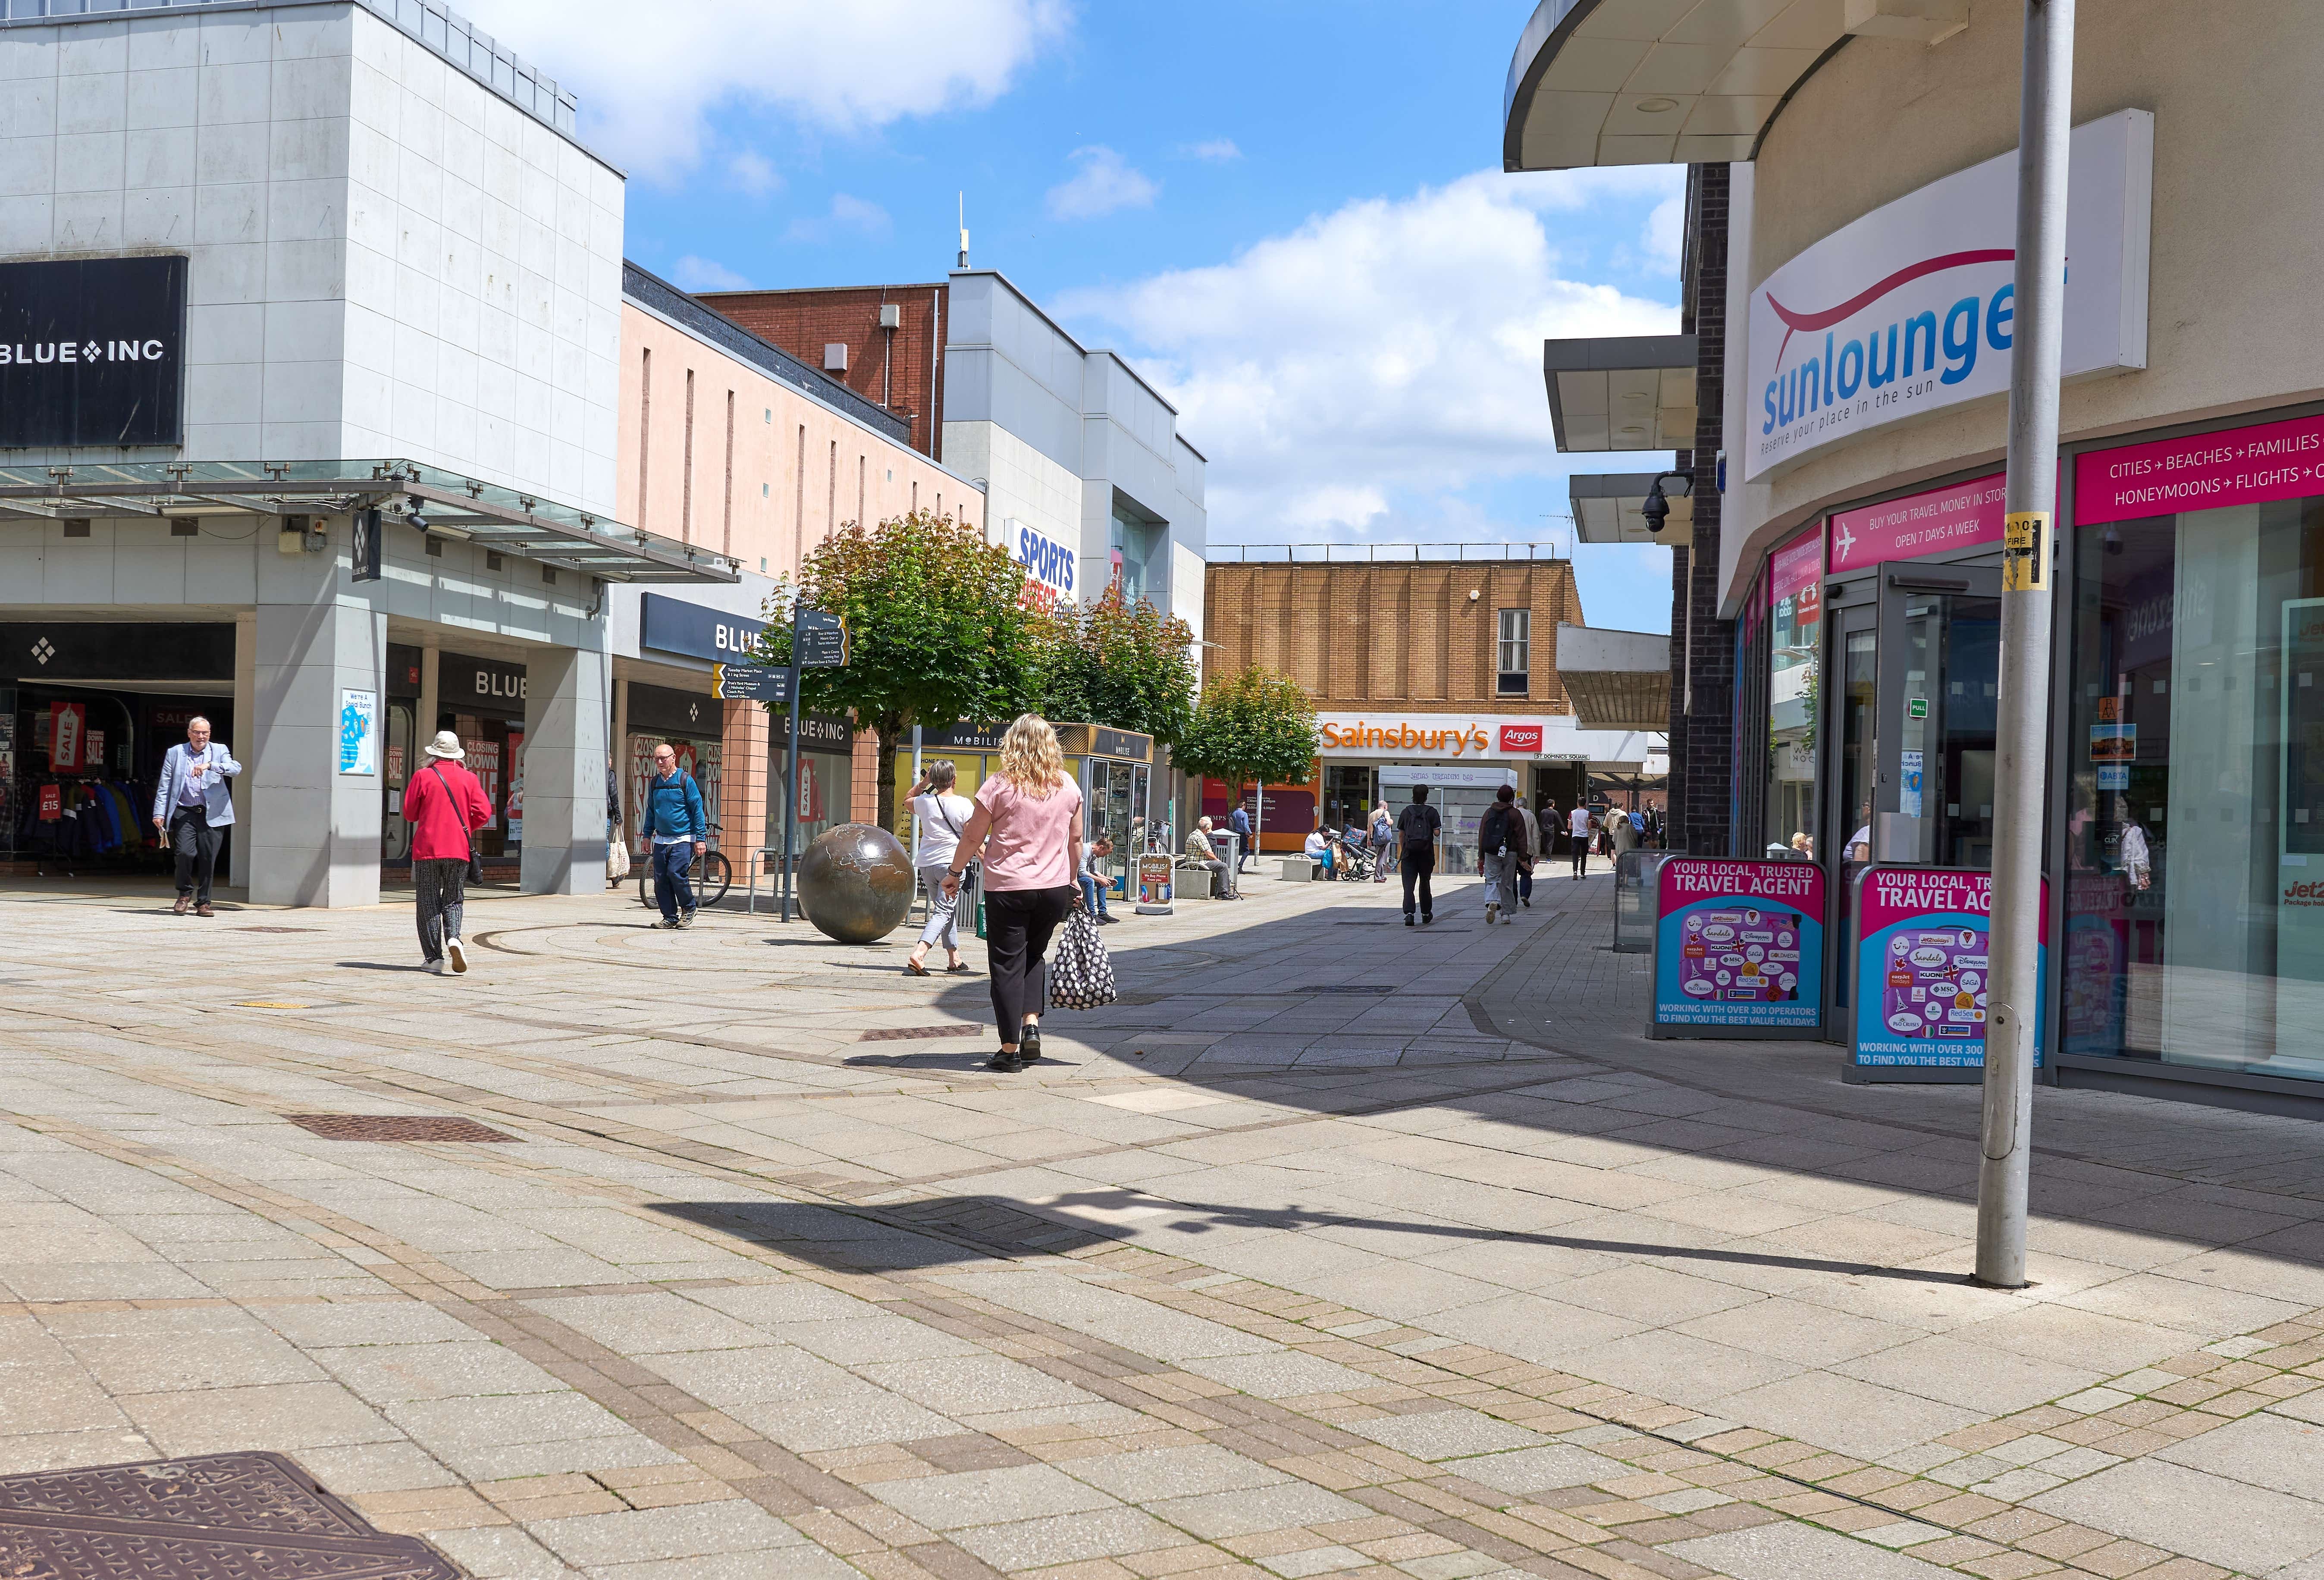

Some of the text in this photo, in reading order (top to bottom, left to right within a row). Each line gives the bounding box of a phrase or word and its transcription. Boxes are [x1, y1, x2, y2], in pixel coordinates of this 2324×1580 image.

[0, 339, 164, 364] BLUE INC
[1761, 379, 1933, 456] Reserve your place in the sun
[2110, 434, 2319, 479] CITIES BEACHES FAMILIES
[2115, 467, 2299, 506] HONEYMOONS FLIGHTS
[1869, 516, 1885, 530] BUY
[1887, 511, 1907, 526] YOUR
[1910, 504, 1938, 520] TRAVEL
[1941, 495, 1971, 514] MONEY
[1973, 493, 1982, 506] IN
[1896, 519, 1979, 548] OPEN 7 DAYS A WEEK
[2008, 537, 2026, 545] FIRE
[1019, 527, 1073, 591] SPORTS
[157, 713, 192, 723] SALE
[826, 723, 844, 740] INC
[1323, 721, 1489, 756] Sainsbury's
[1504, 729, 1538, 742] Argos
[61, 721, 72, 761] SALE
[467, 742, 499, 754] CLOSING
[87, 742, 103, 764] SALE
[1116, 746, 1129, 756] MOBILISE
[389, 757, 402, 779] SALE
[467, 754, 498, 769] DOWN
[2107, 772, 2126, 780] ABTA
[43, 801, 58, 810] £15
[1673, 862, 1814, 878] YOUR LOCAL, TRUSTED
[1674, 875, 1813, 895] TRAVEL AGENT
[1876, 873, 1970, 892] YOUR LOCAL,
[1877, 887, 1957, 909] TRAVEL
[1706, 928, 1731, 936] Sandals
[1914, 952, 1942, 962] Sandals
[1659, 1004, 1700, 1012] WORKING
[1769, 1007, 1816, 1015] OPERATORS
[1777, 1017, 1815, 1025] HOLIDAYS
[1860, 1043, 1982, 1054] WORKING WITH OVER 300
[1859, 1055, 1961, 1066] TO FIND YOU THE BEST
